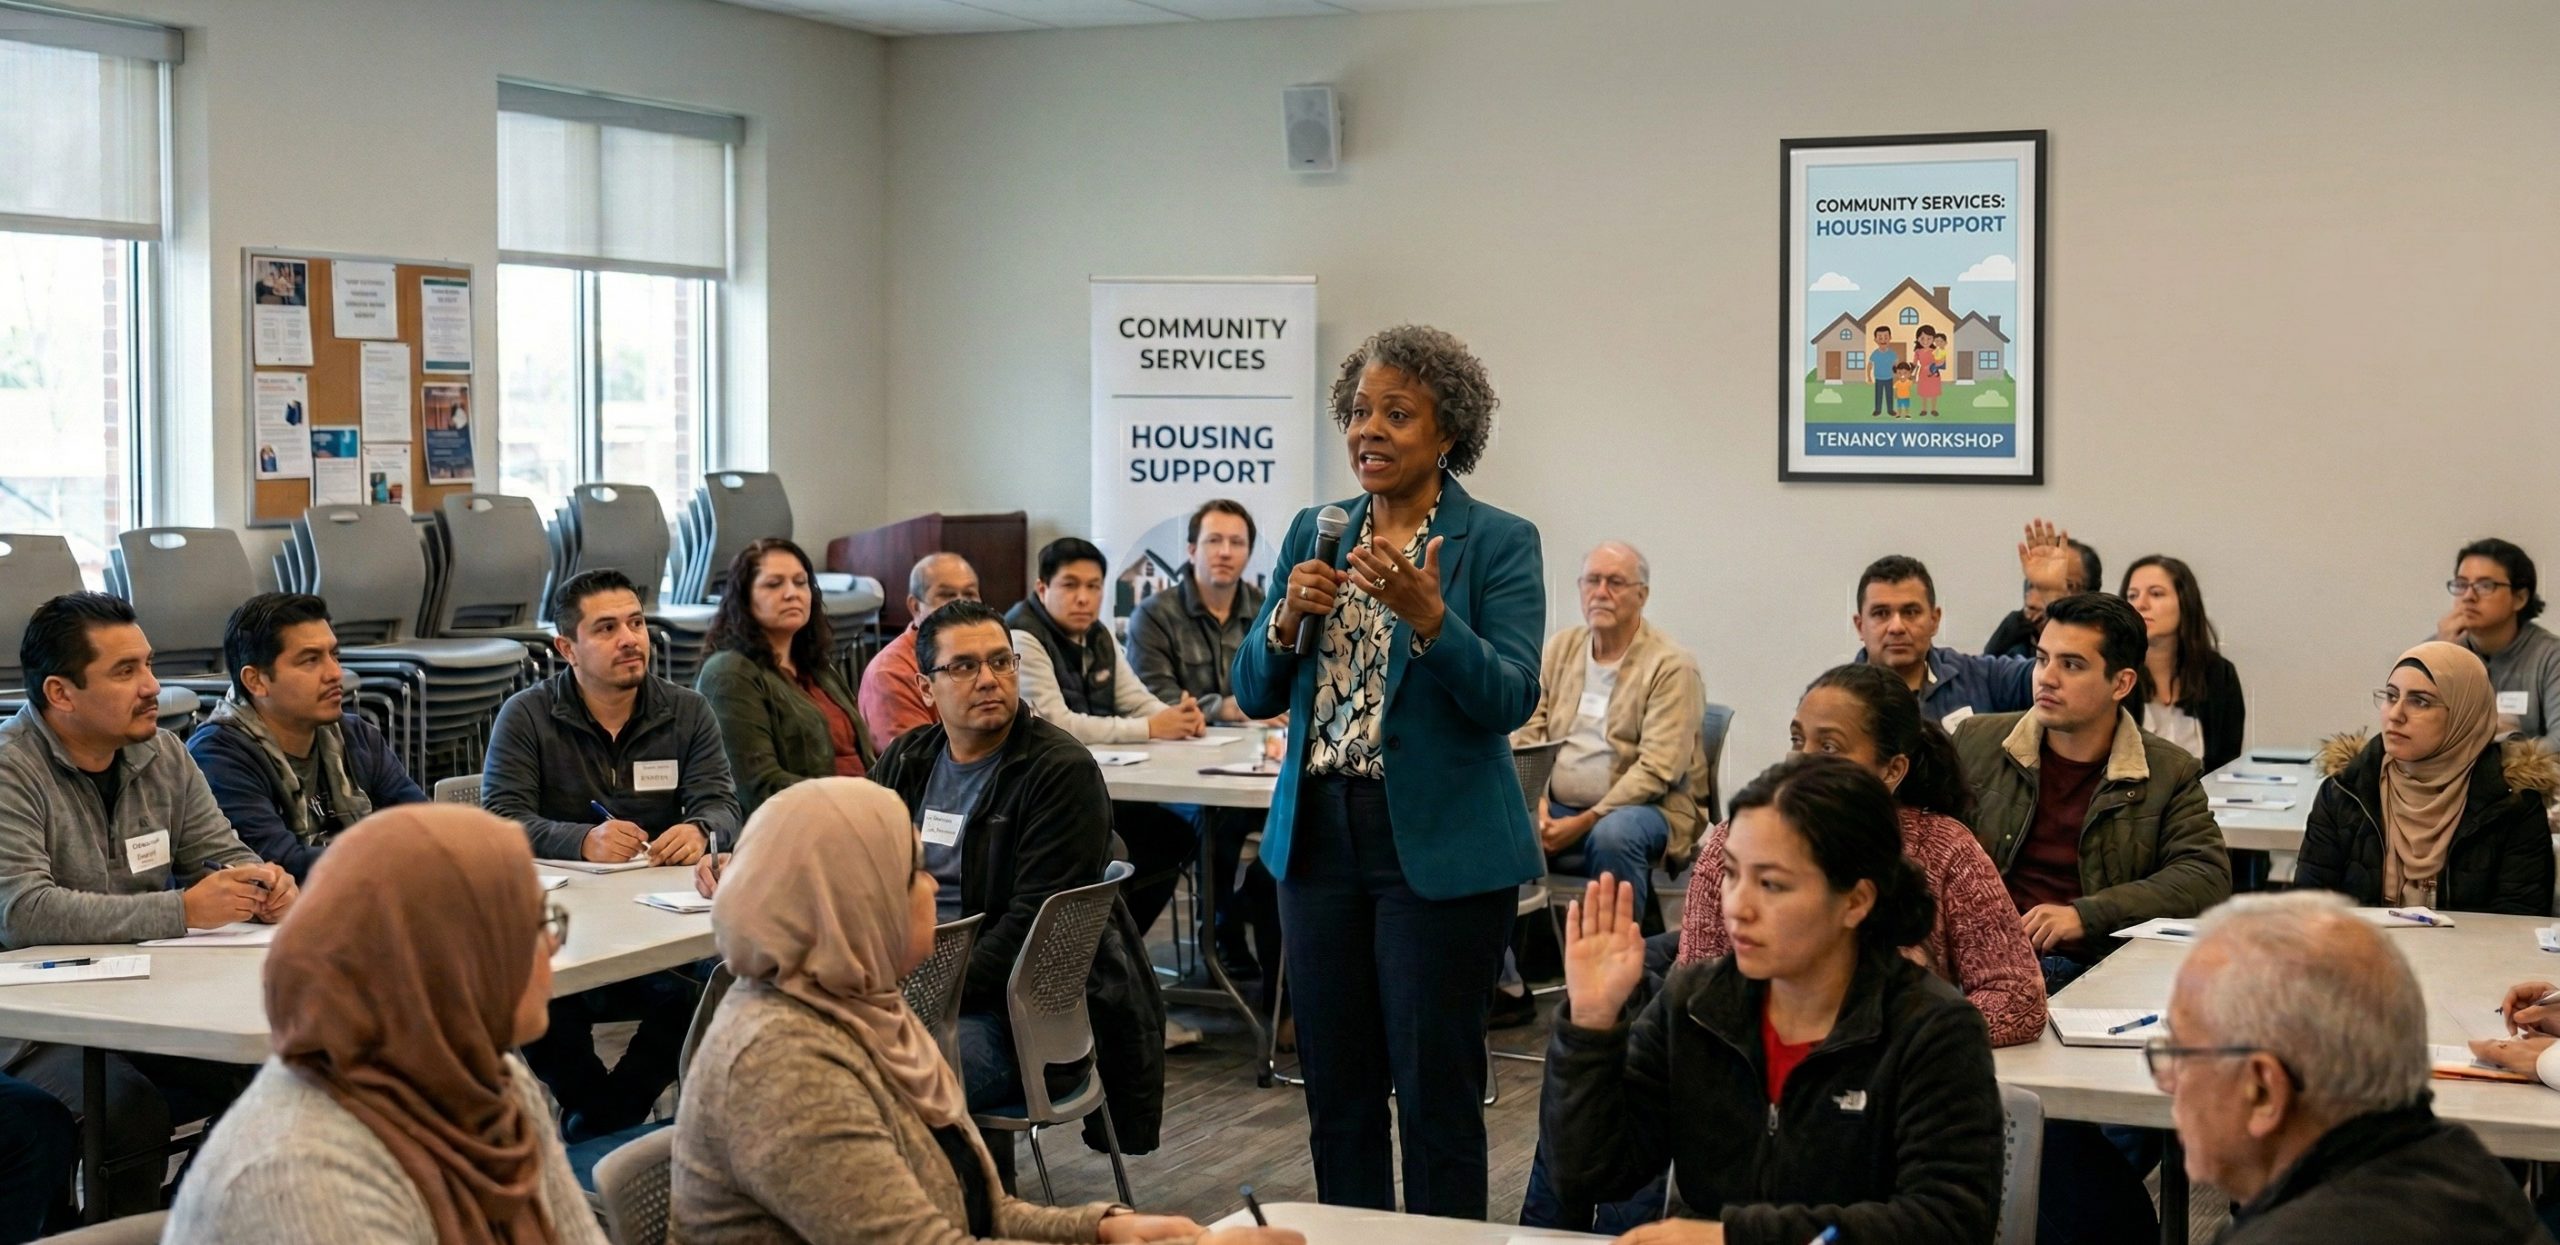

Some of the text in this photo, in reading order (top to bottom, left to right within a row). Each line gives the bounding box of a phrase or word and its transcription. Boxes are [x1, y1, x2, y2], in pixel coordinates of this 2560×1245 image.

[1815, 194, 2006, 214] COMMUNITY SERVICES:
[1816, 215, 2007, 237] HOUSING SUPPORT
[1118, 317, 1288, 339] COMMUNITY
[1140, 348, 1266, 370] SERVICES
[1131, 425, 1274, 450] HOUSING
[1816, 431, 2004, 448] TENANCY WORKSHOP
[1129, 458, 1276, 484] SUPPORT
